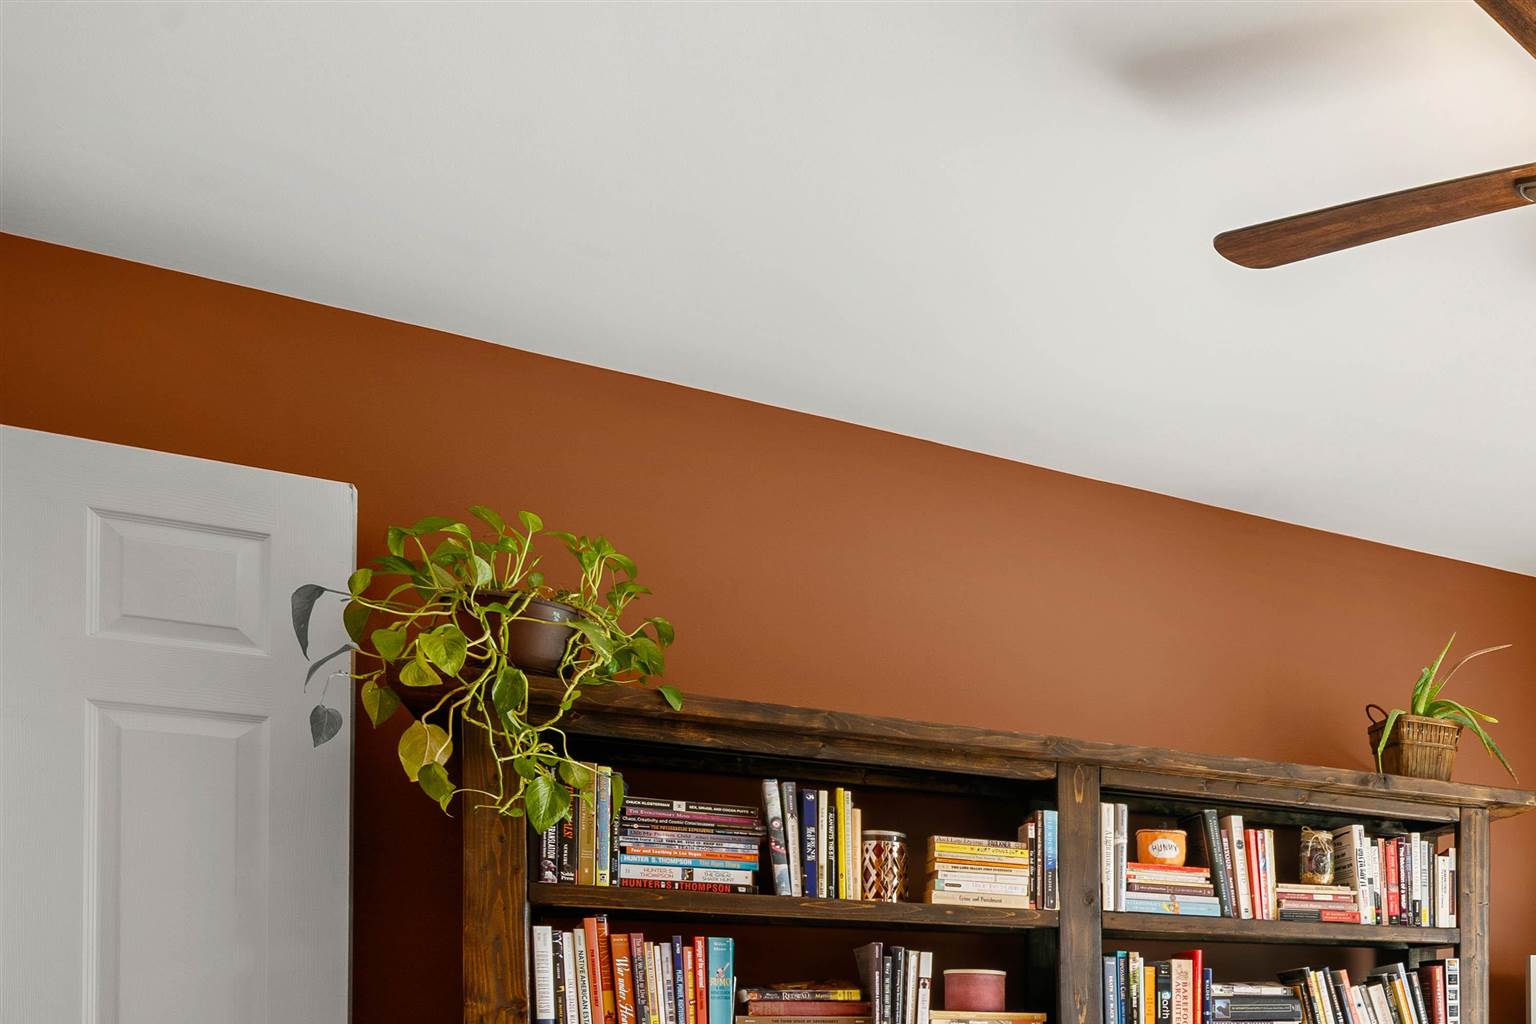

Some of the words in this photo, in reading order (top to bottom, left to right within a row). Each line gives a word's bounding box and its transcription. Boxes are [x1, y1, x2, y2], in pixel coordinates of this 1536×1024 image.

[624, 855, 649, 863] HUNTER
[659, 857, 692, 865] THOMPSON
[622, 879, 661, 888] HUNTER
[680, 884, 731, 893] THOMPSON
[616, 956, 629, 976] War
[580, 975, 588, 1010] AMERICAN
[618, 978, 629, 1000] under
